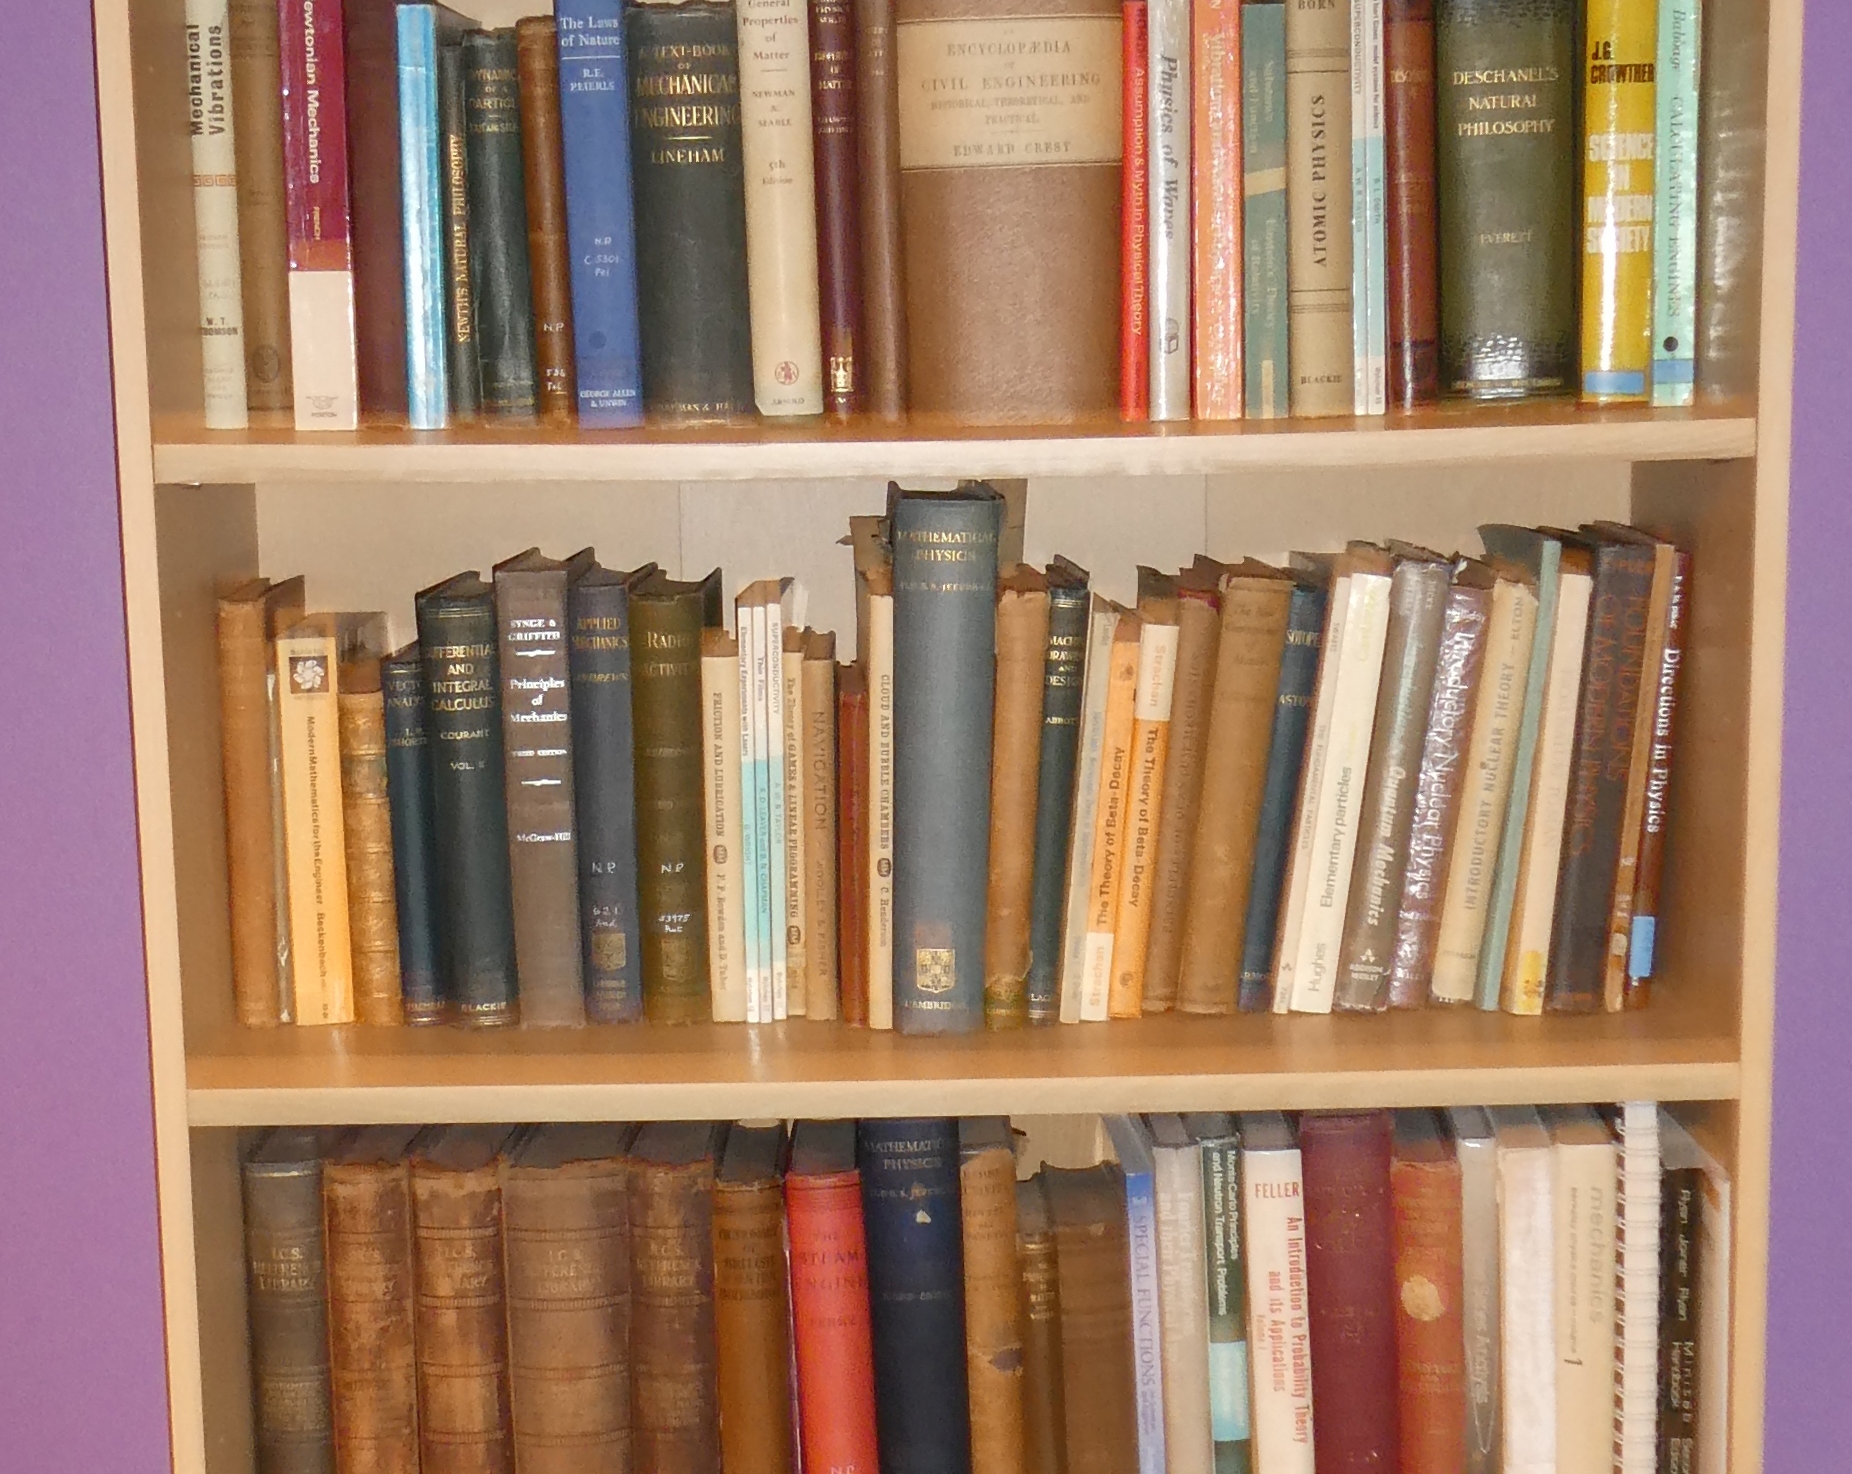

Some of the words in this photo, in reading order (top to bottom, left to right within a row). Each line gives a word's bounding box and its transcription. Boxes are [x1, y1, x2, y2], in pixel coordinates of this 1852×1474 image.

[560, 17, 583, 29] The
[588, 16, 619, 29] Laws
[562, 34, 575, 46] of
[579, 33, 621, 46] Nature
[742, 15, 799, 29] Properties
[765, 32, 777, 43] of
[753, 49, 790, 60] Matter
[1453, 67, 1559, 84] DESCHANEL'S
[1590, 63, 1655, 84] CROWTHER
[187, 25, 203, 136] Mechanical
[208, 25, 226, 135] Vibrations
[570, 81, 615, 92] PEIERLS
[752, 89, 796, 99] NEWMAN
[921, 76, 968, 92] CIVIL
[982, 72, 1101, 90] ENGINEERING
[1158, 53, 1178, 136] Physics
[1132, 67, 1145, 156] Assumption
[1458, 117, 1555, 136] PHILOSOPHY
[305, 89, 320, 184] Mechanics
[651, 148, 725, 163] LINEHAM
[953, 143, 1015, 157] EDWARD
[1164, 144, 1178, 170] of
[1311, 94, 1327, 185] PHYSICS
[1132, 170, 1145, 206] Myth
[1312, 191, 1328, 267] ATOMIC
[1132, 224, 1145, 284] Physical
[1668, 236, 1681, 318] ENGINES
[1131, 285, 1145, 335] Theory
[1300, 374, 1343, 385] BLACKIE
[432, 680, 493, 694] INTEGRAL
[447, 663, 476, 676] AND
[510, 678, 566, 692] Principles
[1151, 644, 1166, 708] Strachan
[1656, 648, 1681, 738] Directions
[440, 728, 491, 741] COURANT
[510, 710, 568, 724] Mechanics
[1146, 727, 1158, 747] The
[813, 712, 828, 829] NAVIGATION
[1654, 743, 1666, 759] in
[1107, 746, 1125, 828] Beta-Decay
[1140, 751, 1156, 801] Theory
[1421, 750, 1457, 826] Nuclear
[1463, 801, 1491, 910] INTRODUCTORY
[1483, 728, 1503, 794] NUCLEAR
[1494, 662, 1514, 720] THEORY
[1646, 767, 1669, 833] Physics
[1377, 765, 1406, 842] Quantum
[1320, 827, 1343, 909] Elementary
[1333, 766, 1353, 826] particles
[1099, 852, 1115, 900] Theory
[1129, 827, 1148, 907] Beta-Decay
[1369, 845, 1397, 926] Mechanics
[1411, 832, 1444, 900] Physics
[1096, 904, 1109, 926] The
[1088, 945, 1104, 1007] Strachan
[1308, 942, 1326, 992] Hughes
[1254, 1182, 1300, 1199] FELLER
[1133, 1215, 1150, 1280] SPECIAL
[1287, 1217, 1302, 1232] An
[1268, 1270, 1284, 1291] and
[1288, 1237, 1306, 1311] Introduction
[1270, 1297, 1285, 1314] its
[1291, 1316, 1304, 1328] to
[1136, 1289, 1156, 1387] FUNCTIONS
[1268, 1319, 1287, 1393] Applications
[1290, 1333, 1308, 1398] Probability
[1292, 1405, 1309, 1444] Theory
